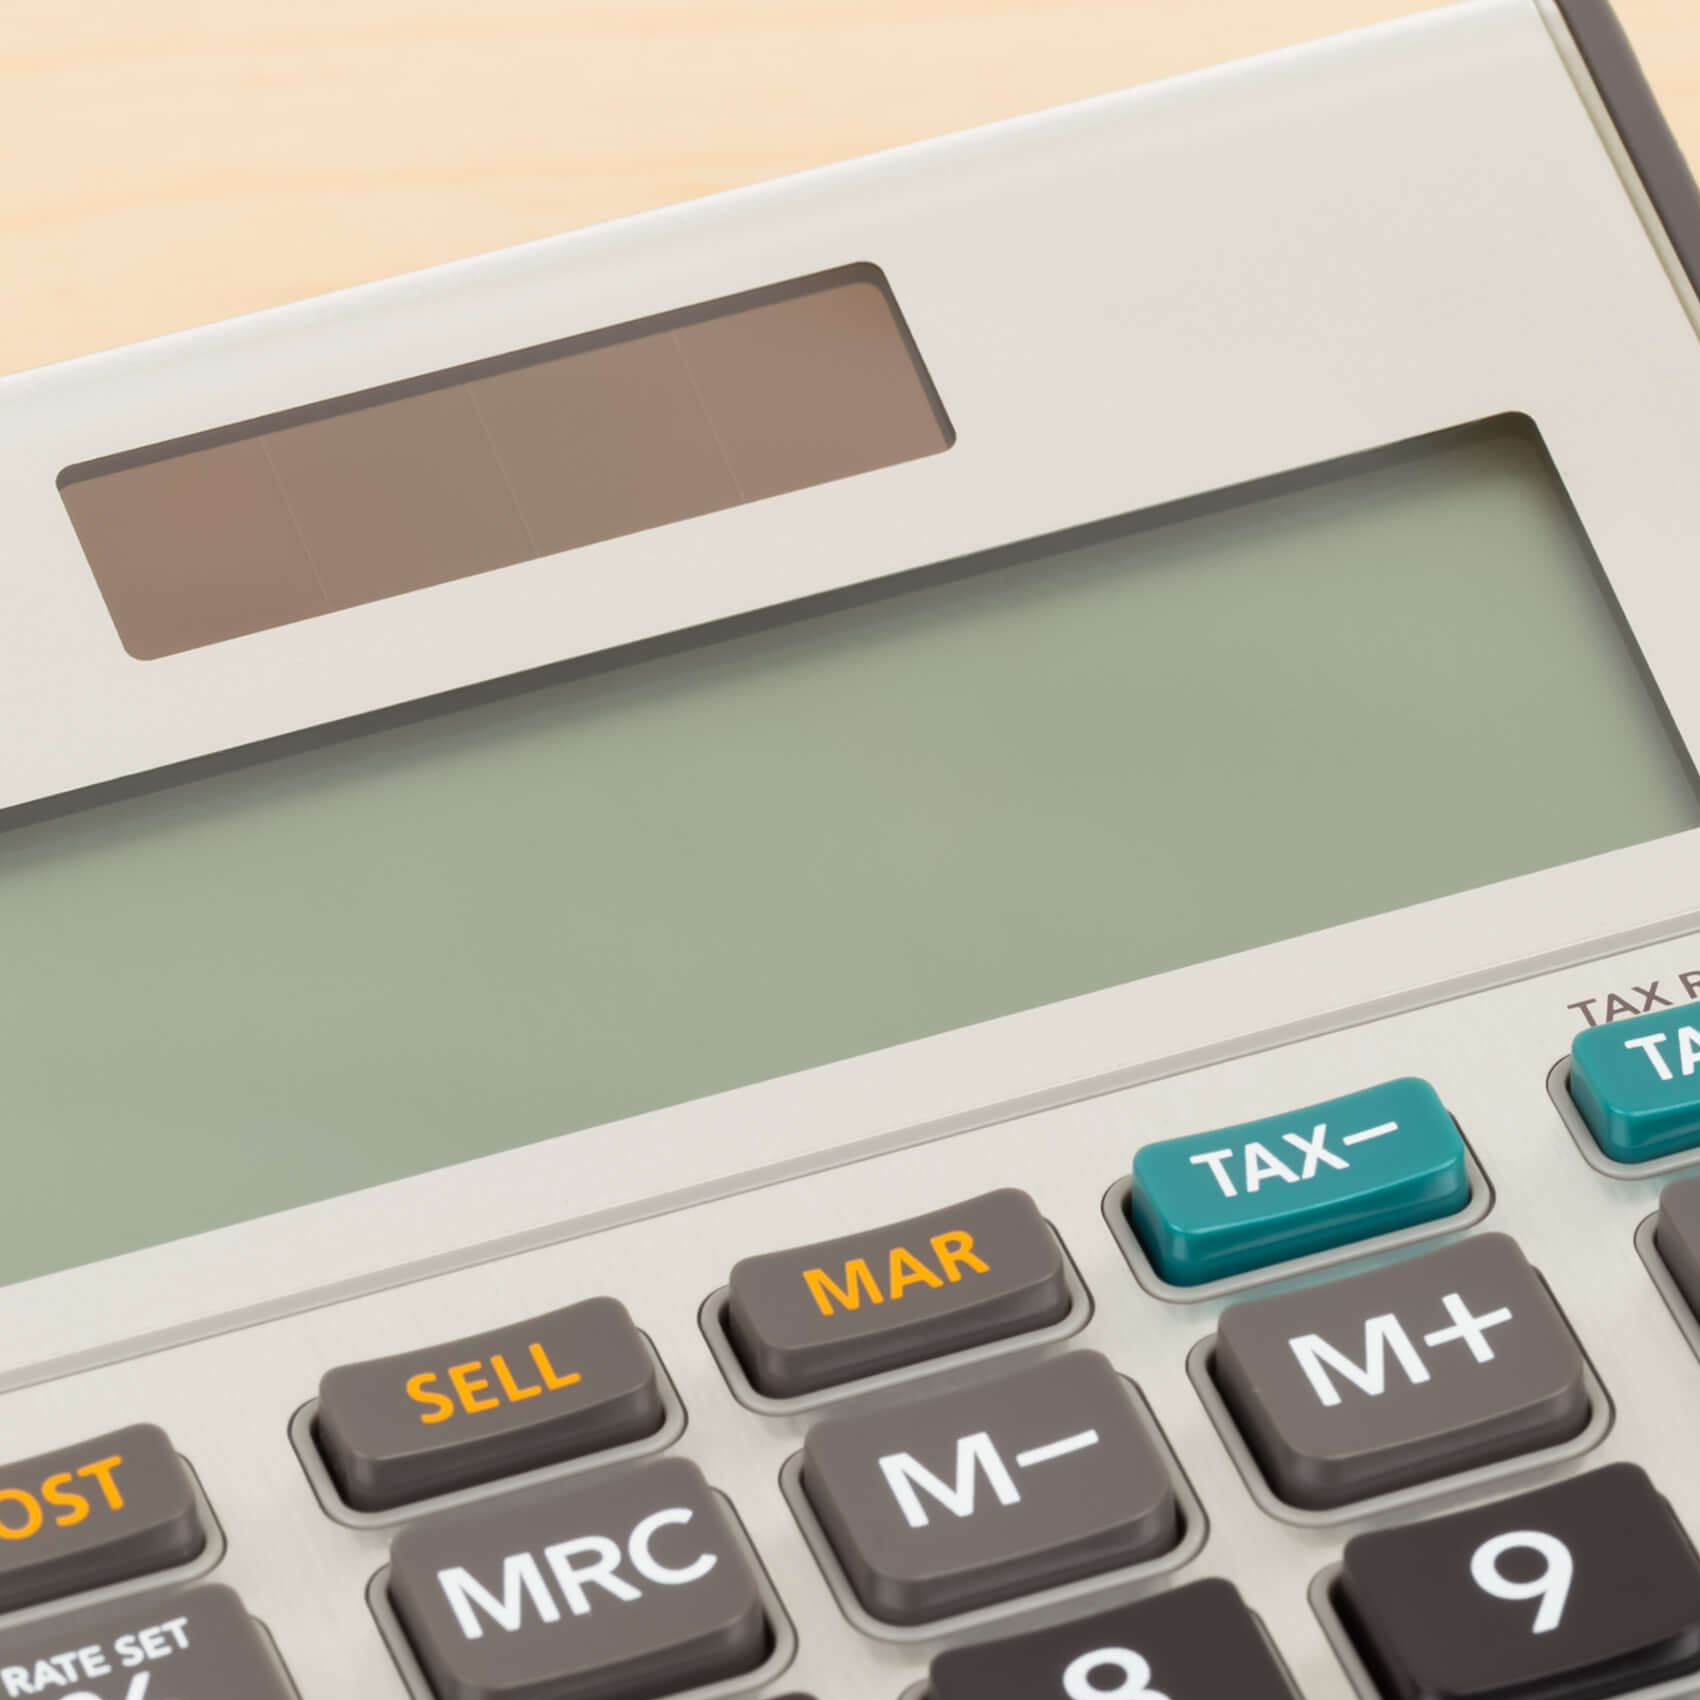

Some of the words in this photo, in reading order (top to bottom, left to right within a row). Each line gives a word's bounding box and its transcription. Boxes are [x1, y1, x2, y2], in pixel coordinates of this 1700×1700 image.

[1567, 981, 1673, 1028] TAX
[803, 1230, 990, 1316] MAR
[406, 1344, 581, 1424] SELL
[1289, 1293, 1512, 1406] M+
[437, 1507, 718, 1639] MRC
[1472, 1532, 1572, 1632] 9
[0, 1645, 112, 1698] RATE
[114, 1616, 190, 1668] SET
